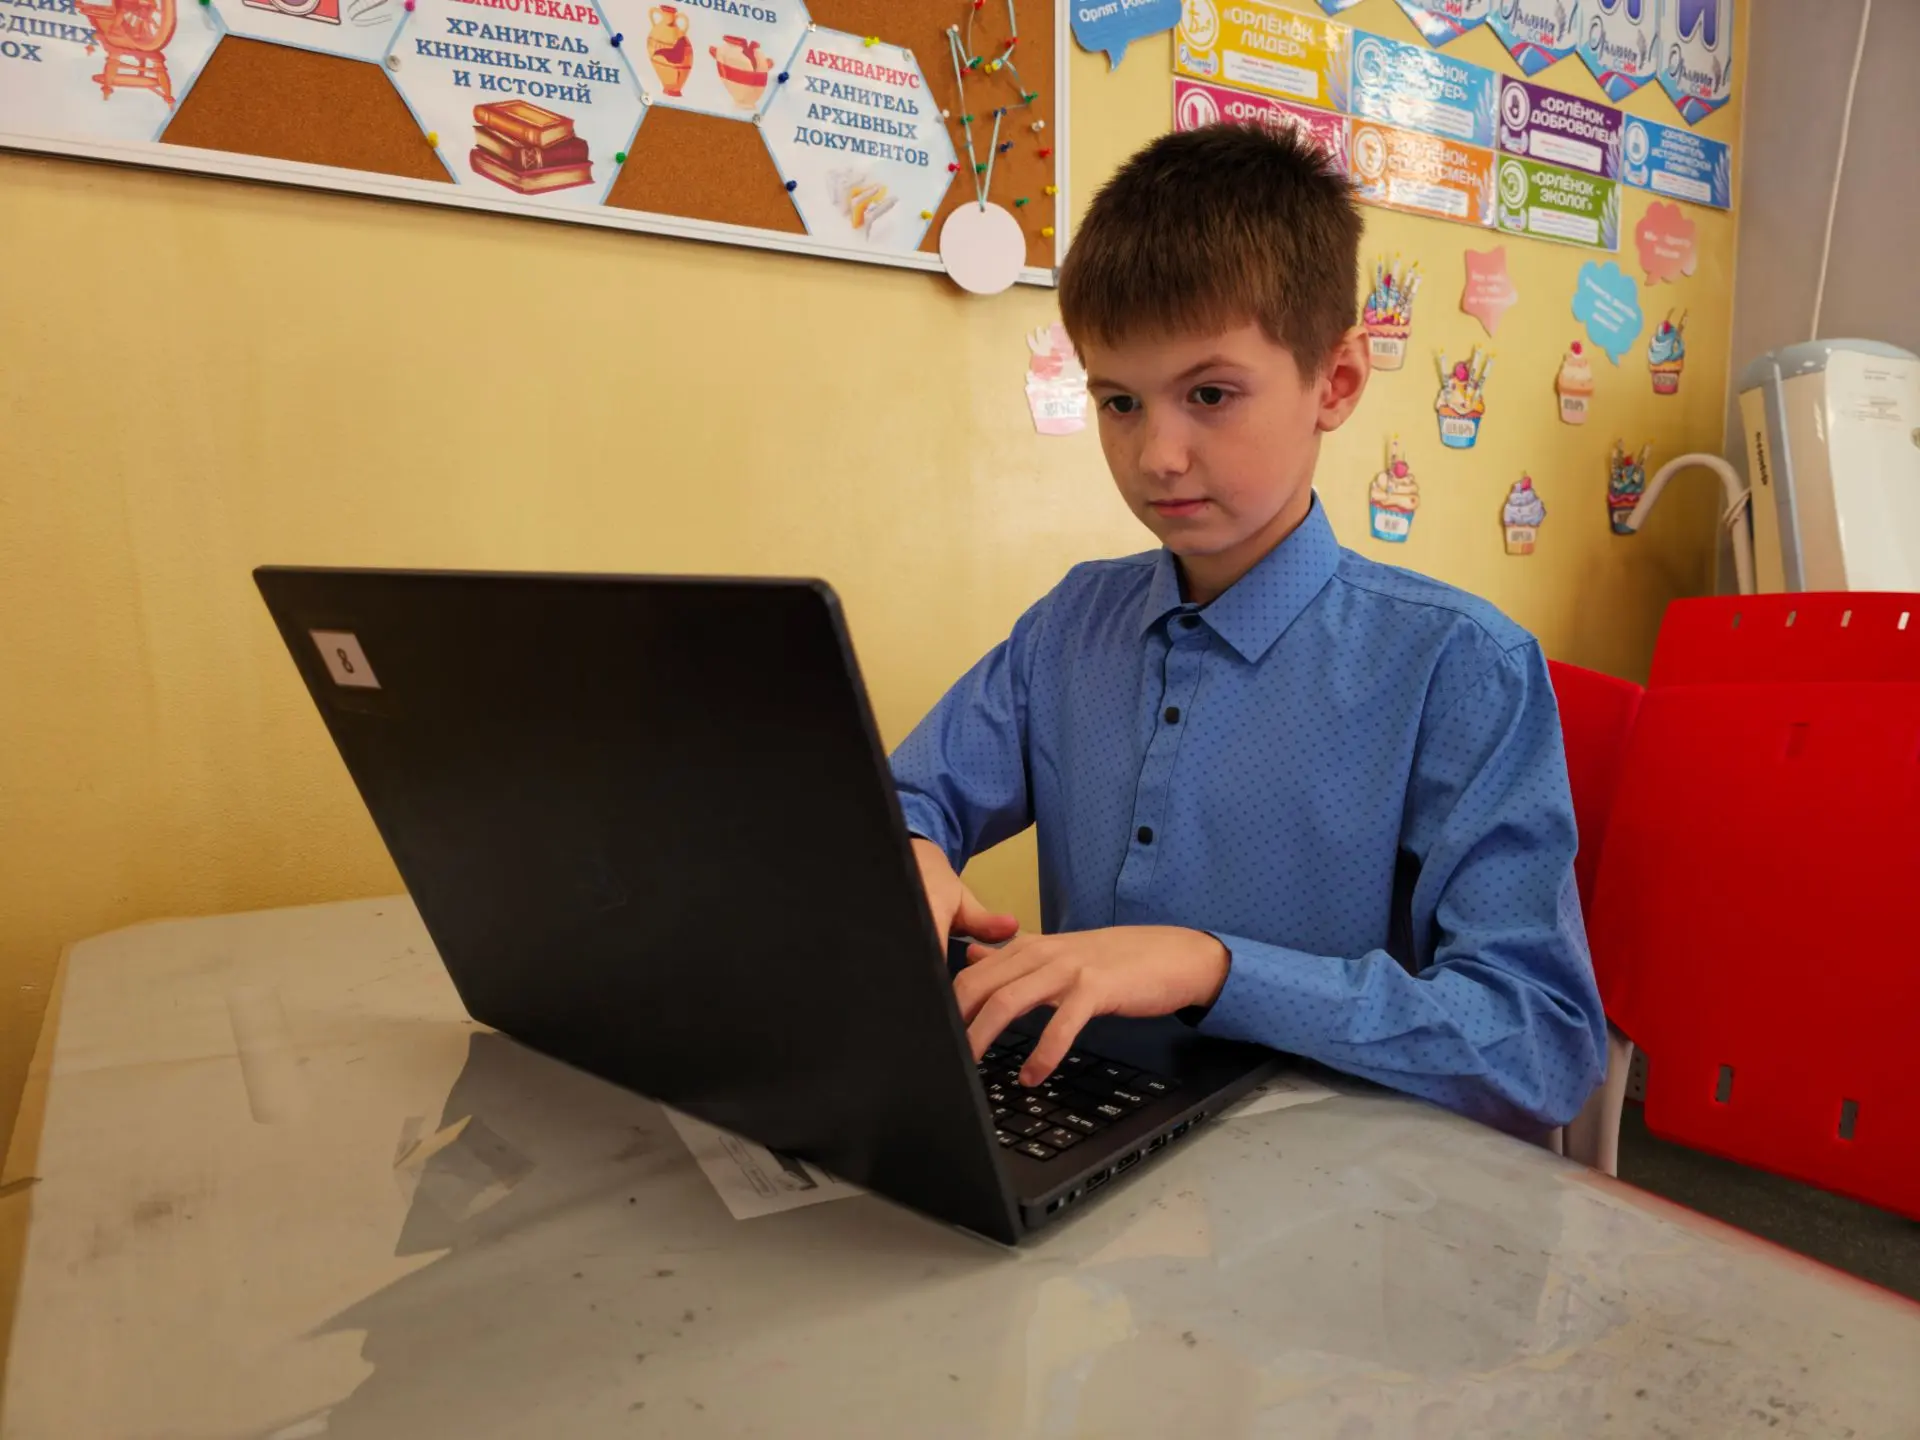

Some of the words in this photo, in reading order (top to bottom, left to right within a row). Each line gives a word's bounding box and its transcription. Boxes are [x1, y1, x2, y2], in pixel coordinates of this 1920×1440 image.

[0, 0, 77, 15] ДИЯ
[448, 0, 600, 25] ИОТЕКАРЬ
[674, 0, 777, 24] ОНАТОВ
[446, 17, 590, 54] ХРАНИТЕЛЬ
[415, 38, 552, 75] КНИЖНЫХ
[558, 58, 621, 85] ТАЙН
[805, 48, 921, 89] АРХИВАРИУС
[452, 69, 472, 88] И
[479, 73, 593, 104] ИСТОРИЙ
[804, 75, 919, 116] ХРАНИТЕЛЬ
[806, 103, 918, 140] АРХИВНЫХ
[1540, 97, 1605, 125] «ОРЛЁНОК
[793, 126, 930, 167] ДОКУМЕНТОВ
[336, 647, 355, 674] 8
